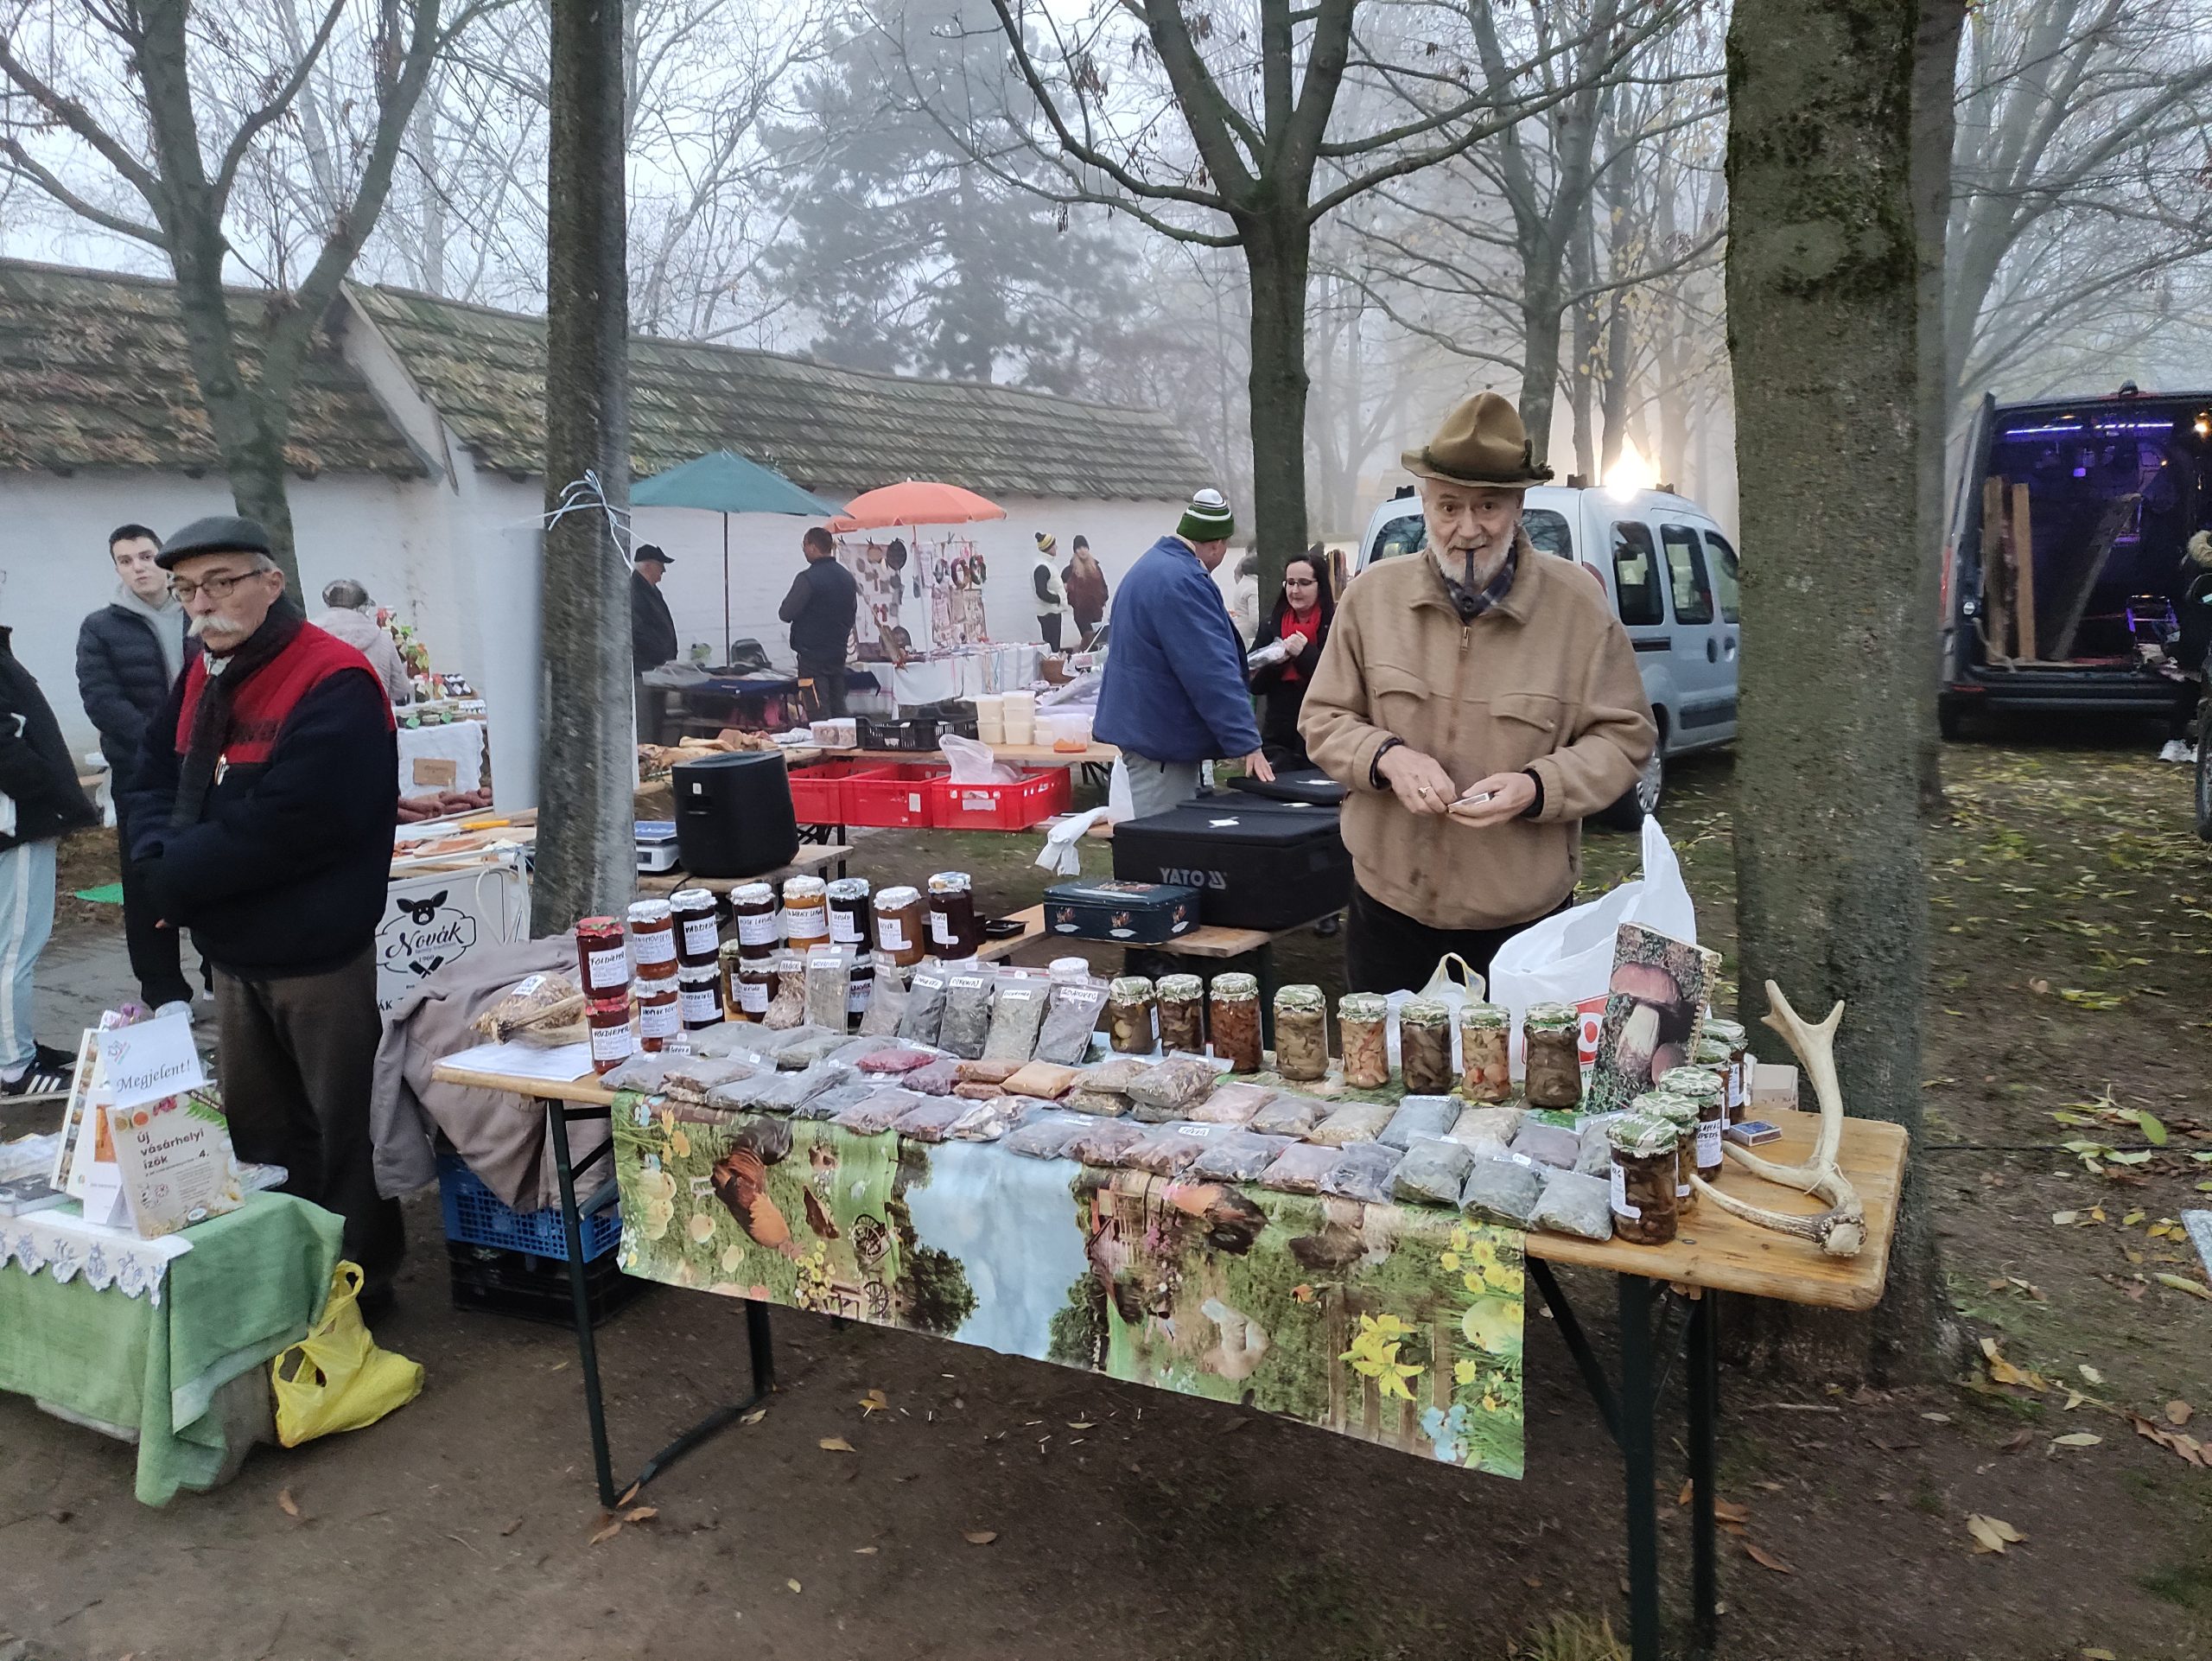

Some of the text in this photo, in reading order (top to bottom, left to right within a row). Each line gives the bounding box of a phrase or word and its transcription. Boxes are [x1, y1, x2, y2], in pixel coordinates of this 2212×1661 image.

[1159, 867, 1205, 886] YATO
[385, 921, 464, 958] Novák
[117, 1060, 191, 1093] Megjelent!
[137, 1130, 150, 1145] Új
[140, 1127, 205, 1156] vásárhelyi
[199, 1149, 210, 1159] 4.
